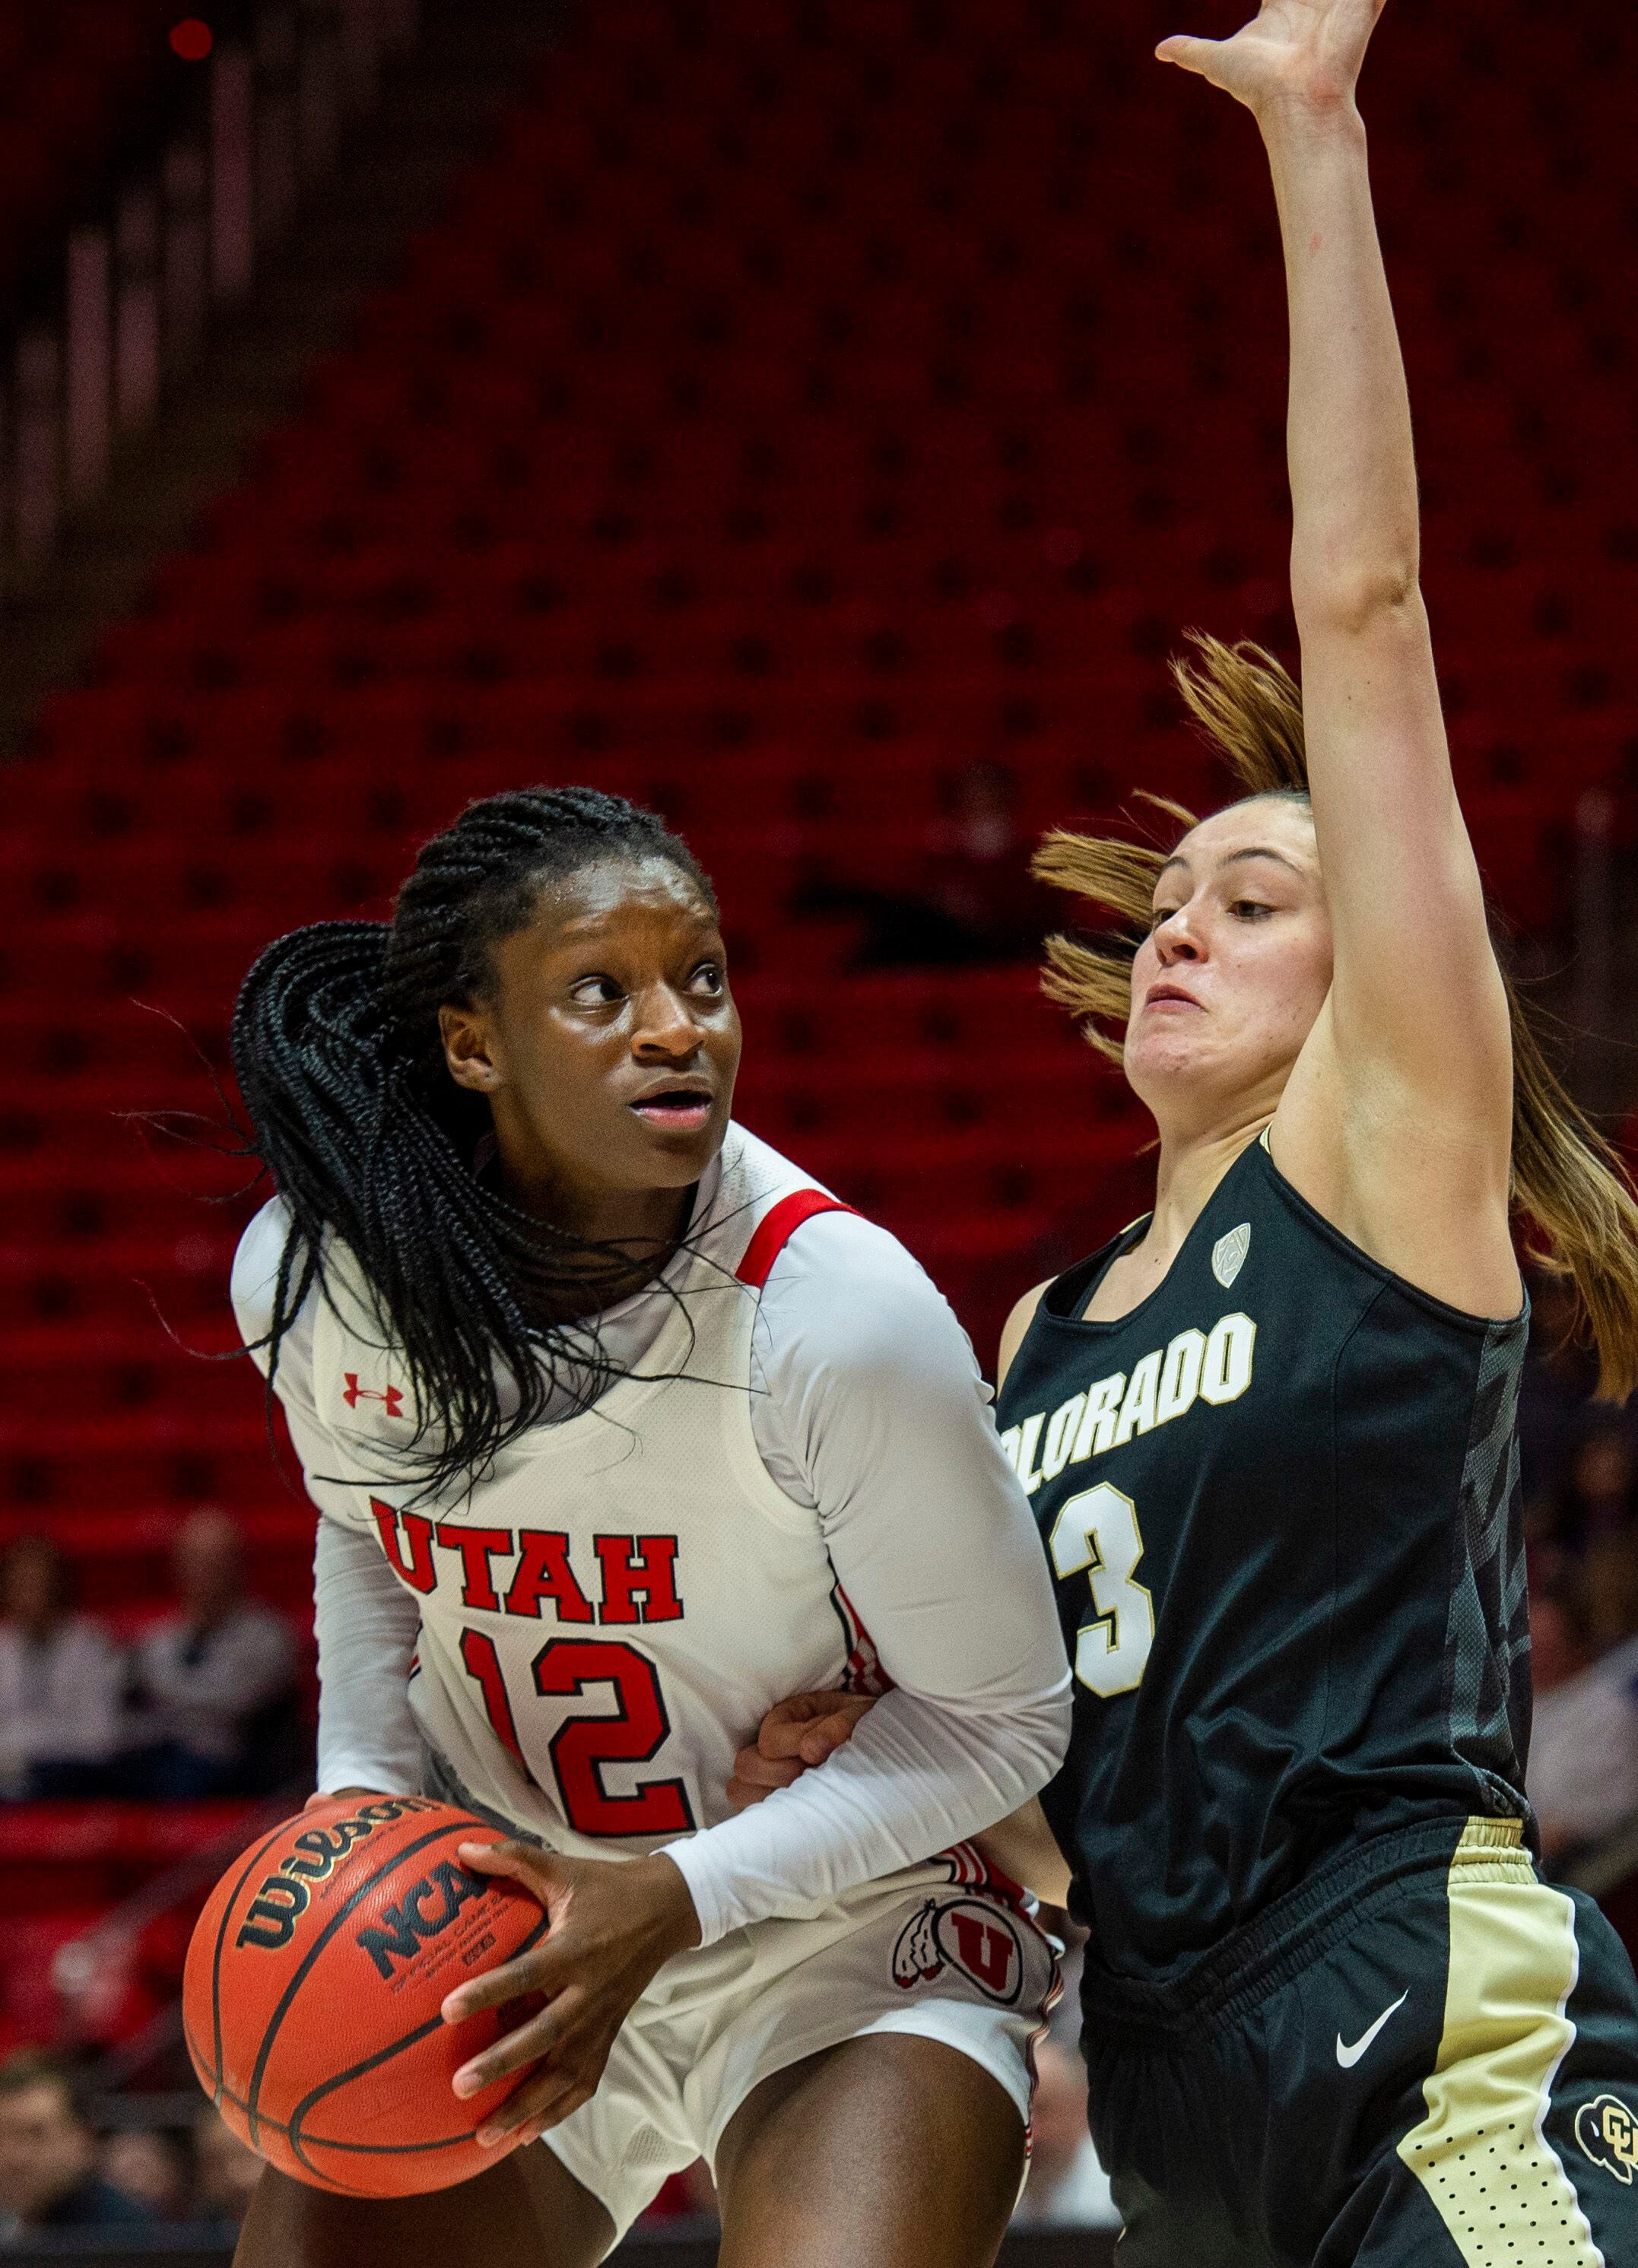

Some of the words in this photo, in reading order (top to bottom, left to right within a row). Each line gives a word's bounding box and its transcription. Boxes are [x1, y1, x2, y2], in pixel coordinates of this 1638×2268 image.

[1000, 1312, 1257, 1496] OLORADO
[369, 1495, 685, 1626] UTAH
[1049, 1480, 1155, 1699] 3
[459, 1626, 697, 1838] 12
[235, 1798, 445, 1951] Wilson
[355, 1860, 488, 1981] NCA
[951, 1911, 1014, 1992] U
